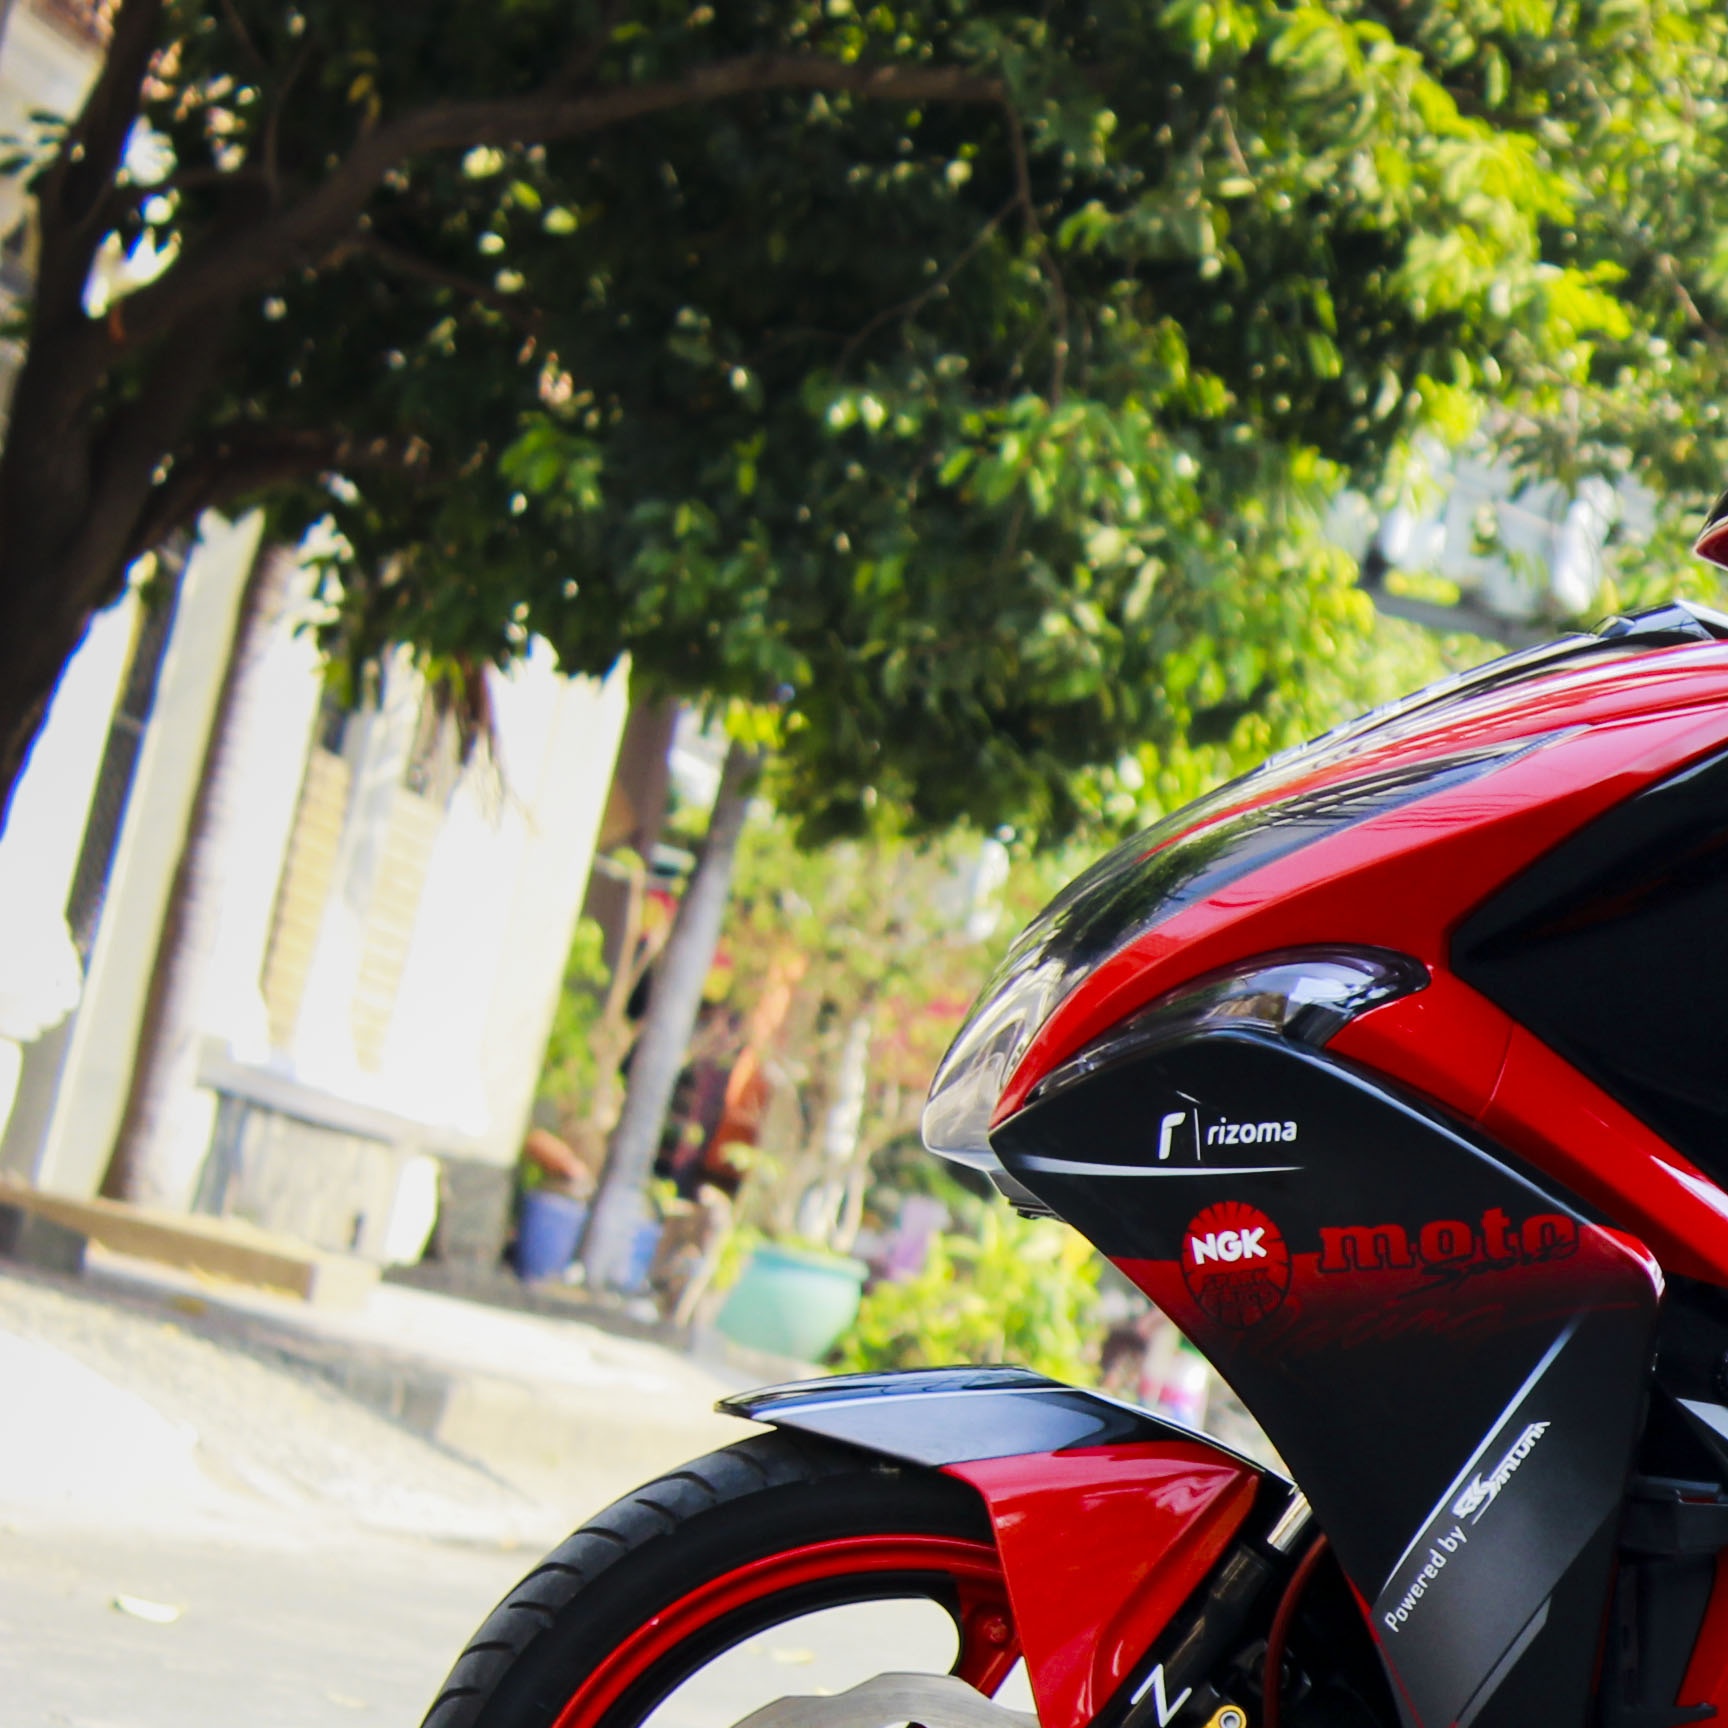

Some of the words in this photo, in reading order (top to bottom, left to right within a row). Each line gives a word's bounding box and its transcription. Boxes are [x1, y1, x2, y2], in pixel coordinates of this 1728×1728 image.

[1207, 1116, 1298, 1146] rizoma
[1191, 1227, 1268, 1265] NGK
[1317, 1207, 1579, 1273] moto
[1384, 1548, 1447, 1633] Powered
[1437, 1525, 1468, 1553] by
